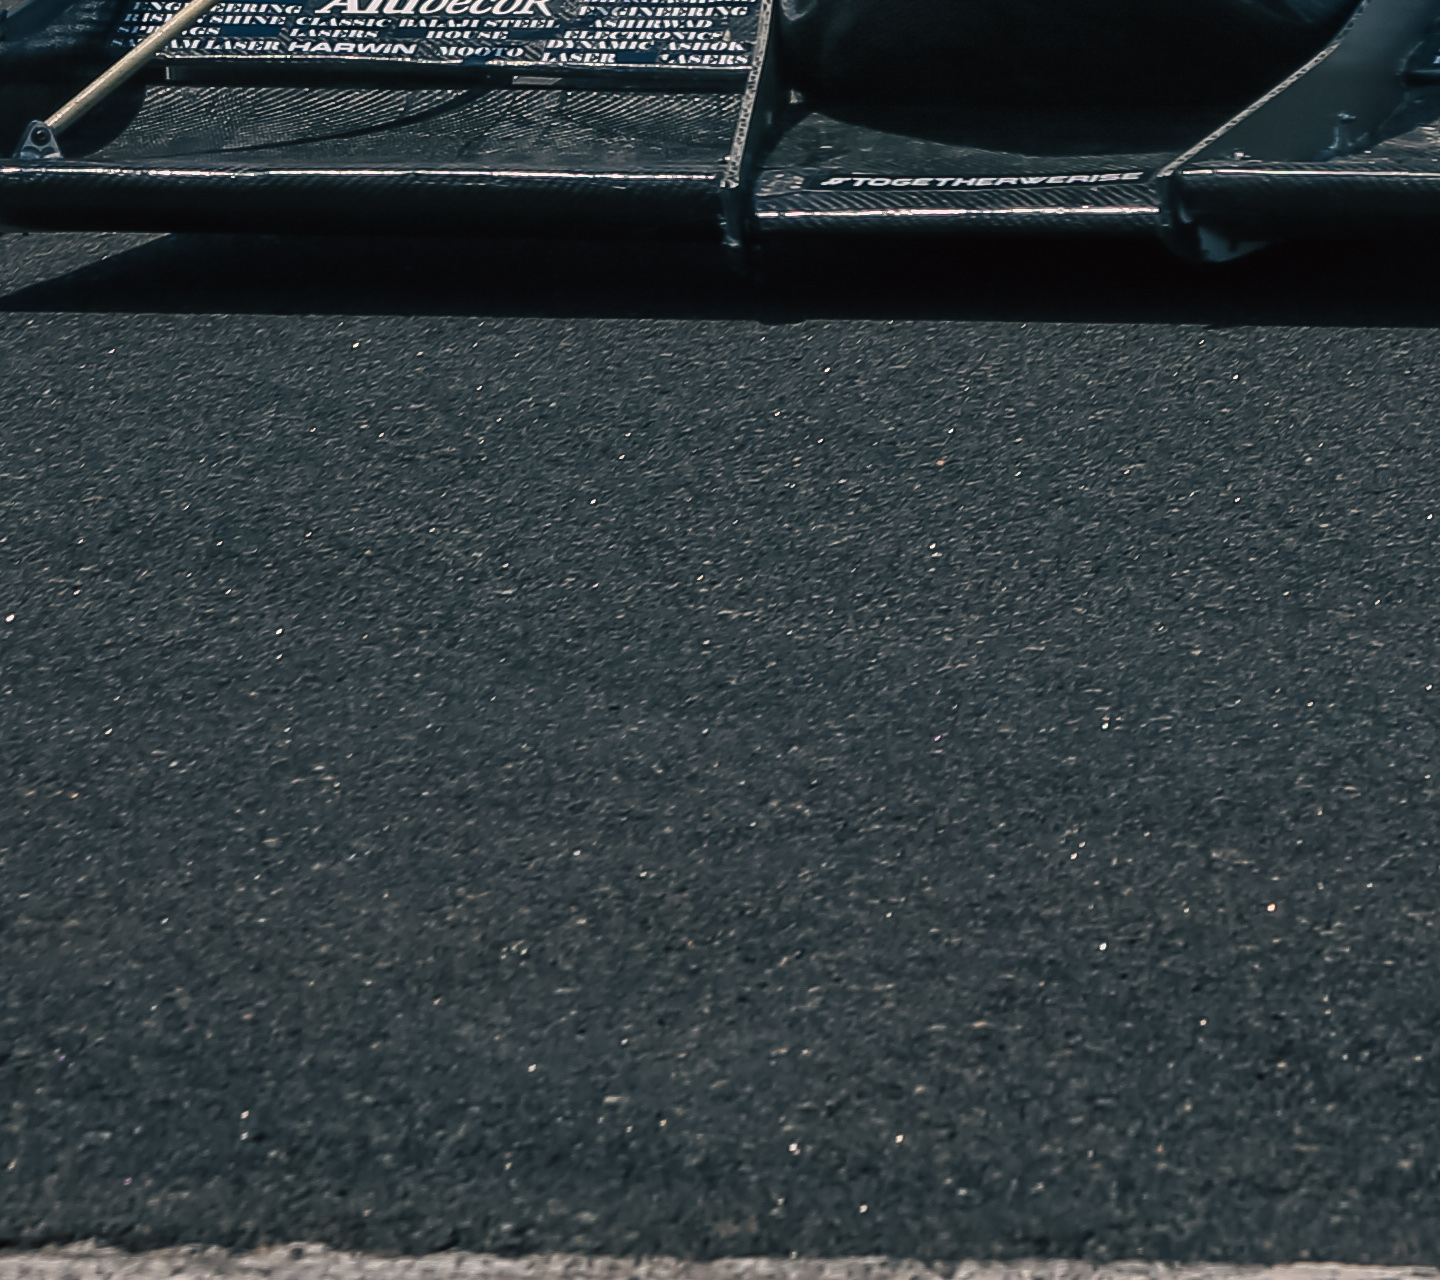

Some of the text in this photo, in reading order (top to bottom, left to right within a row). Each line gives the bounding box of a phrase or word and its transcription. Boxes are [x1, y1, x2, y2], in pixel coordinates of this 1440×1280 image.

[578, 6, 748, 17] ENGINEERING
[209, 15, 287, 25] SHINE
[296, 17, 560, 28] CLASSIC BALAJI STEEL
[289, 28, 380, 38] LASERS
[425, 30, 509, 40] HOUSE
[563, 31, 724, 41] ELECTRONICS
[205, 40, 282, 51] LASER
[287, 41, 418, 54] HARWIN
[546, 40, 747, 52] DYNAMIC ASHOK
[540, 52, 617, 63] LASER
